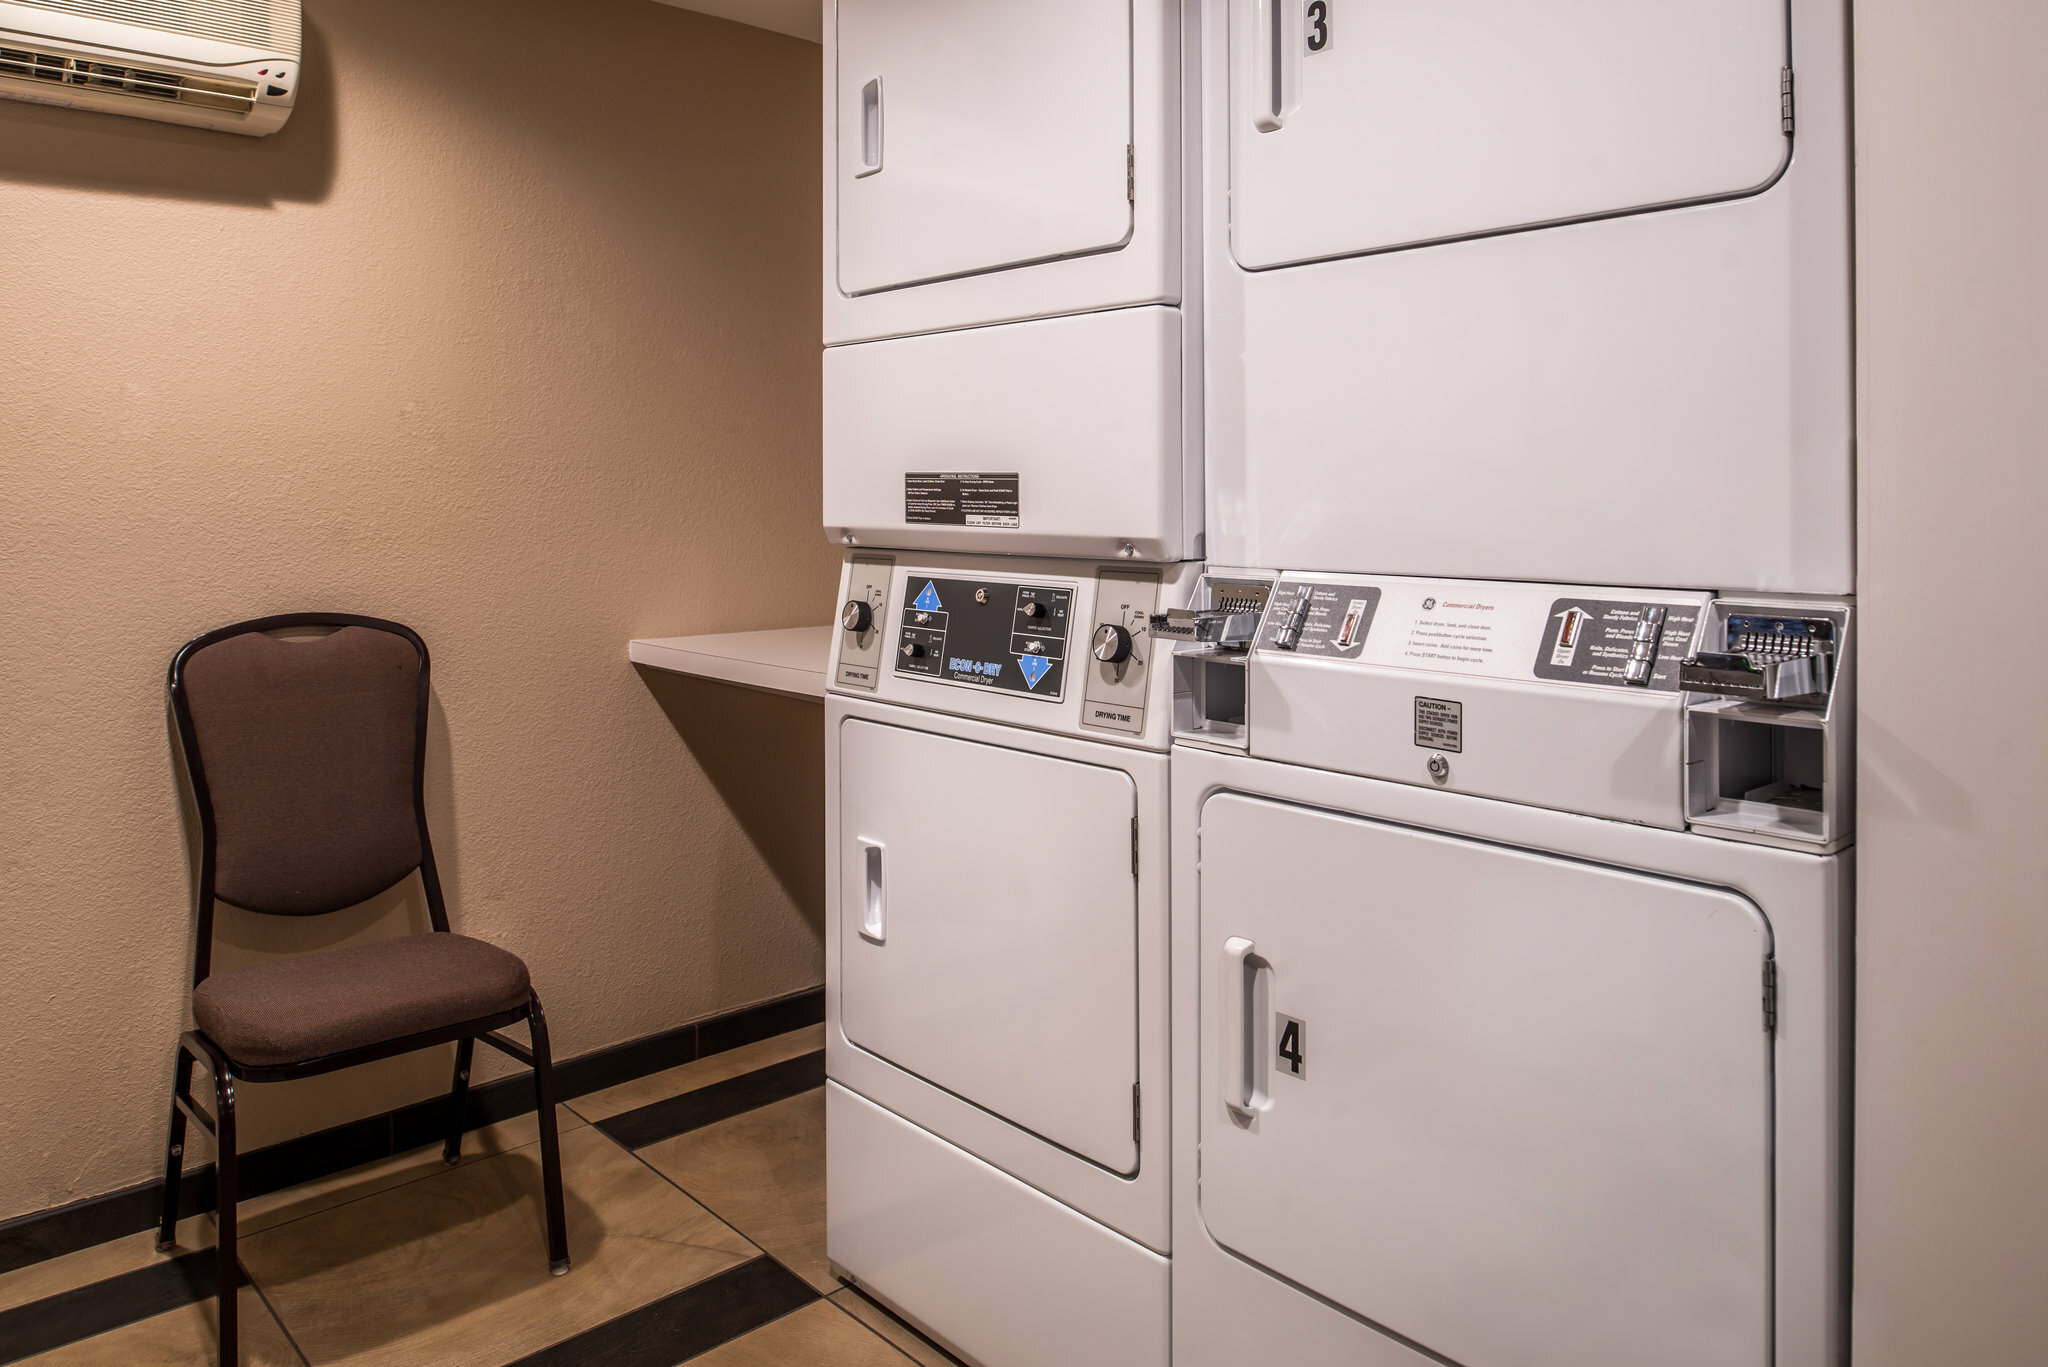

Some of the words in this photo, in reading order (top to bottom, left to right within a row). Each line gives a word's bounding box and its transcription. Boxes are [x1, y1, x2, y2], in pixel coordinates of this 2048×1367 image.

[1308, 0, 1327, 51] 3
[1619, 614, 1638, 622] Fabrics
[954, 671, 980, 682] Commercial
[980, 676, 994, 686] Dryer
[1418, 701, 1446, 711] CAUTION
[1095, 710, 1116, 721] DRYING
[1117, 714, 1131, 722] TIME
[1279, 1020, 1302, 1074] 4
